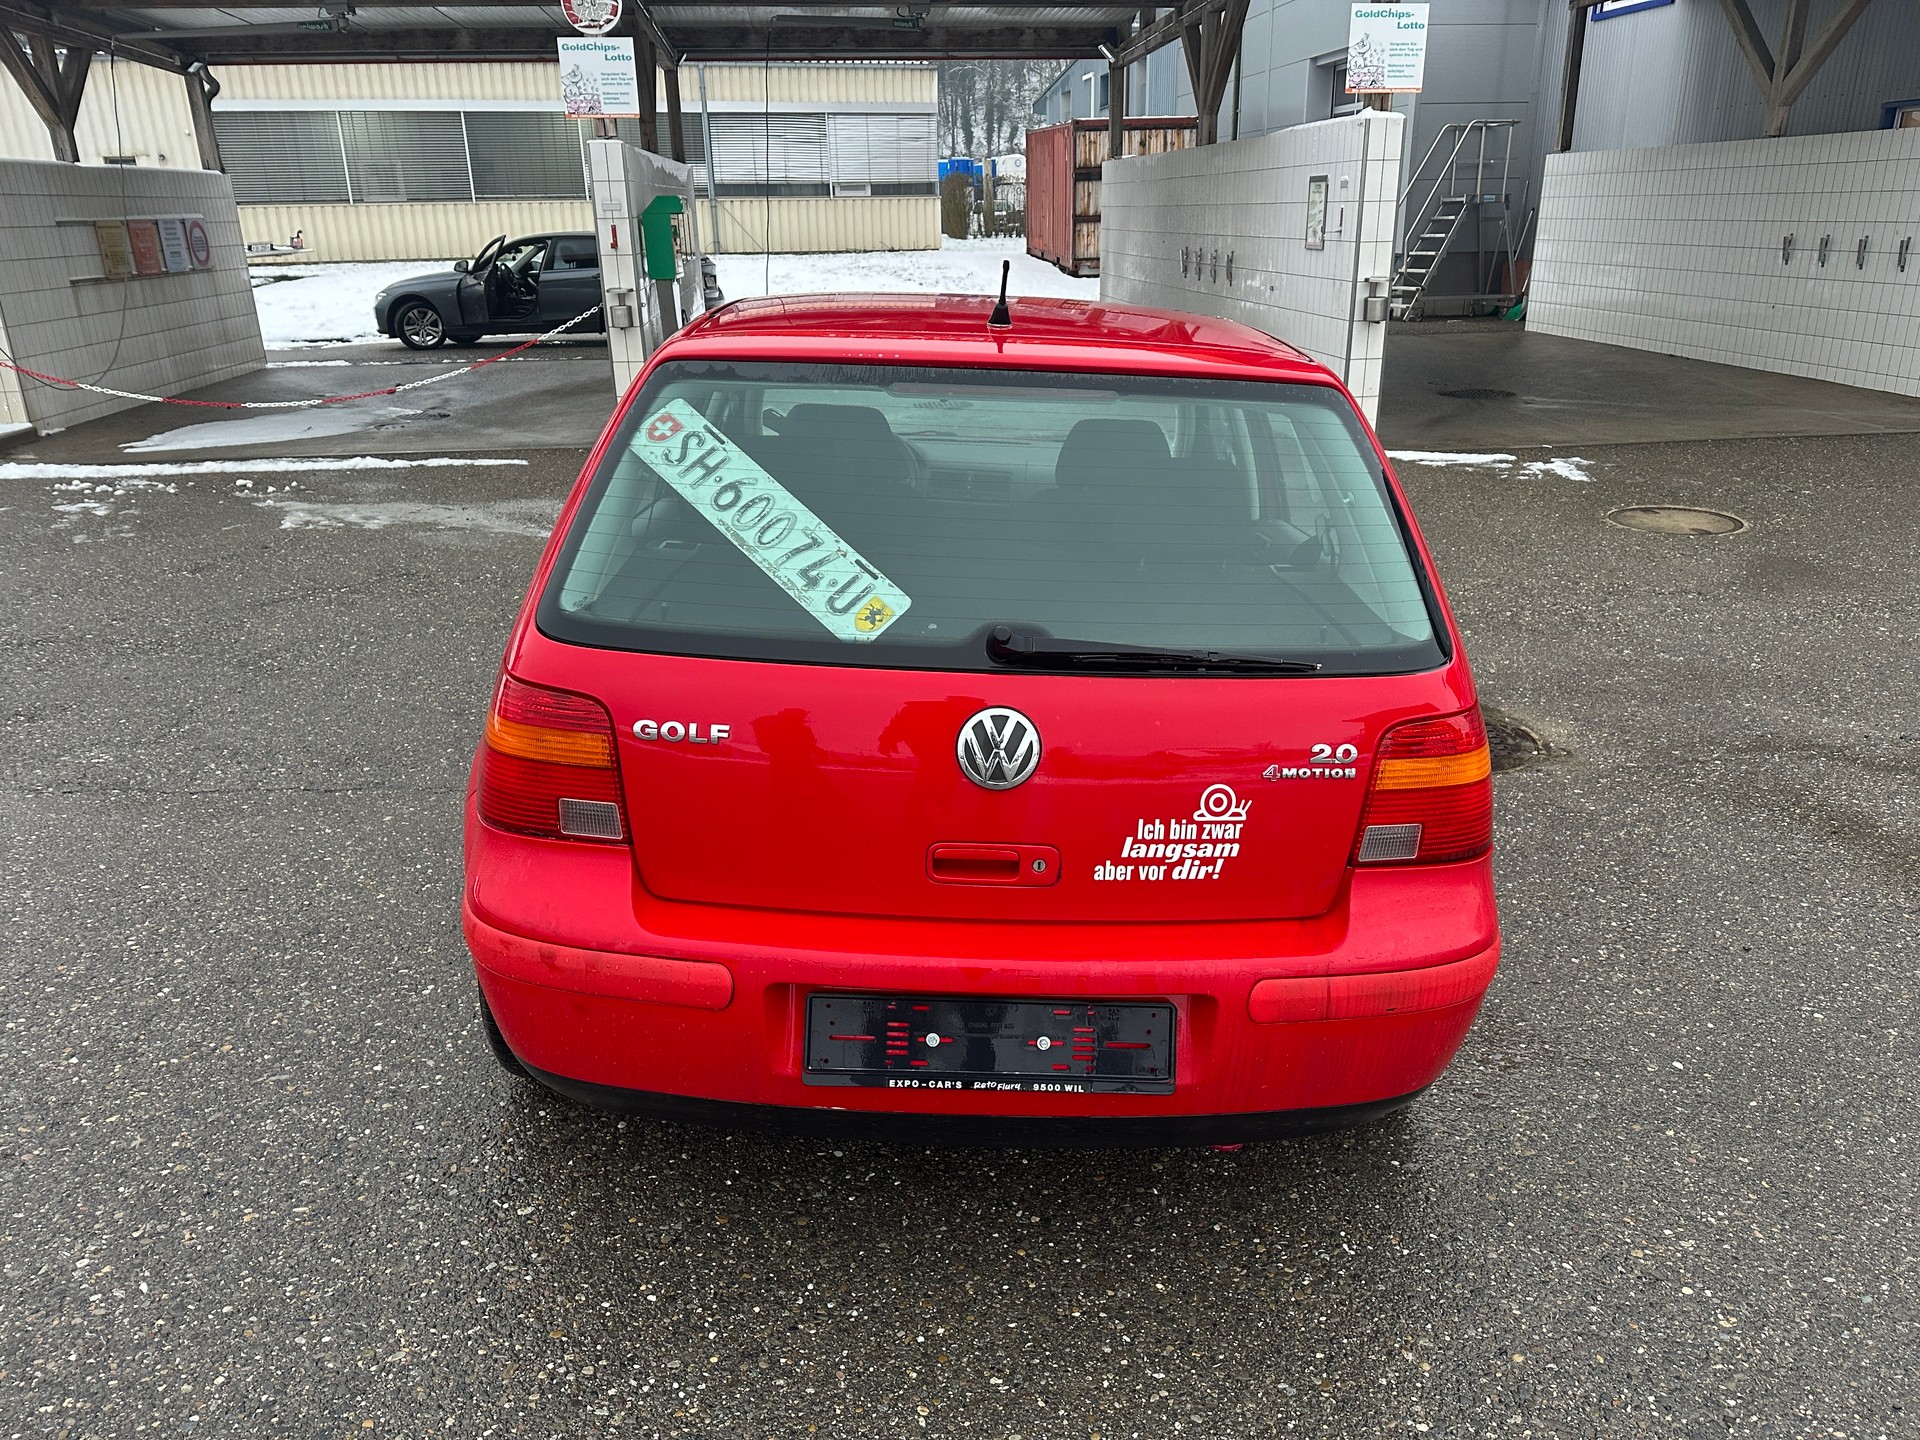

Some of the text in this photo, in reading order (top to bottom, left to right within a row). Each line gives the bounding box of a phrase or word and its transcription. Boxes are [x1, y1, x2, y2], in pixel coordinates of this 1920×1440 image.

[1355, 8, 1414, 19] GoldChips-
[562, 42, 620, 52] GoldChips-
[633, 719, 730, 744] GOLF
[1262, 764, 1356, 781] 4MOTION
[1137, 818, 1243, 840] Ich bin zwar
[1121, 837, 1240, 863] langsam
[1094, 859, 1224, 881] aber vor dir!
[1033, 1083, 1061, 1092] 9500
[1064, 1084, 1084, 1093] WIL
